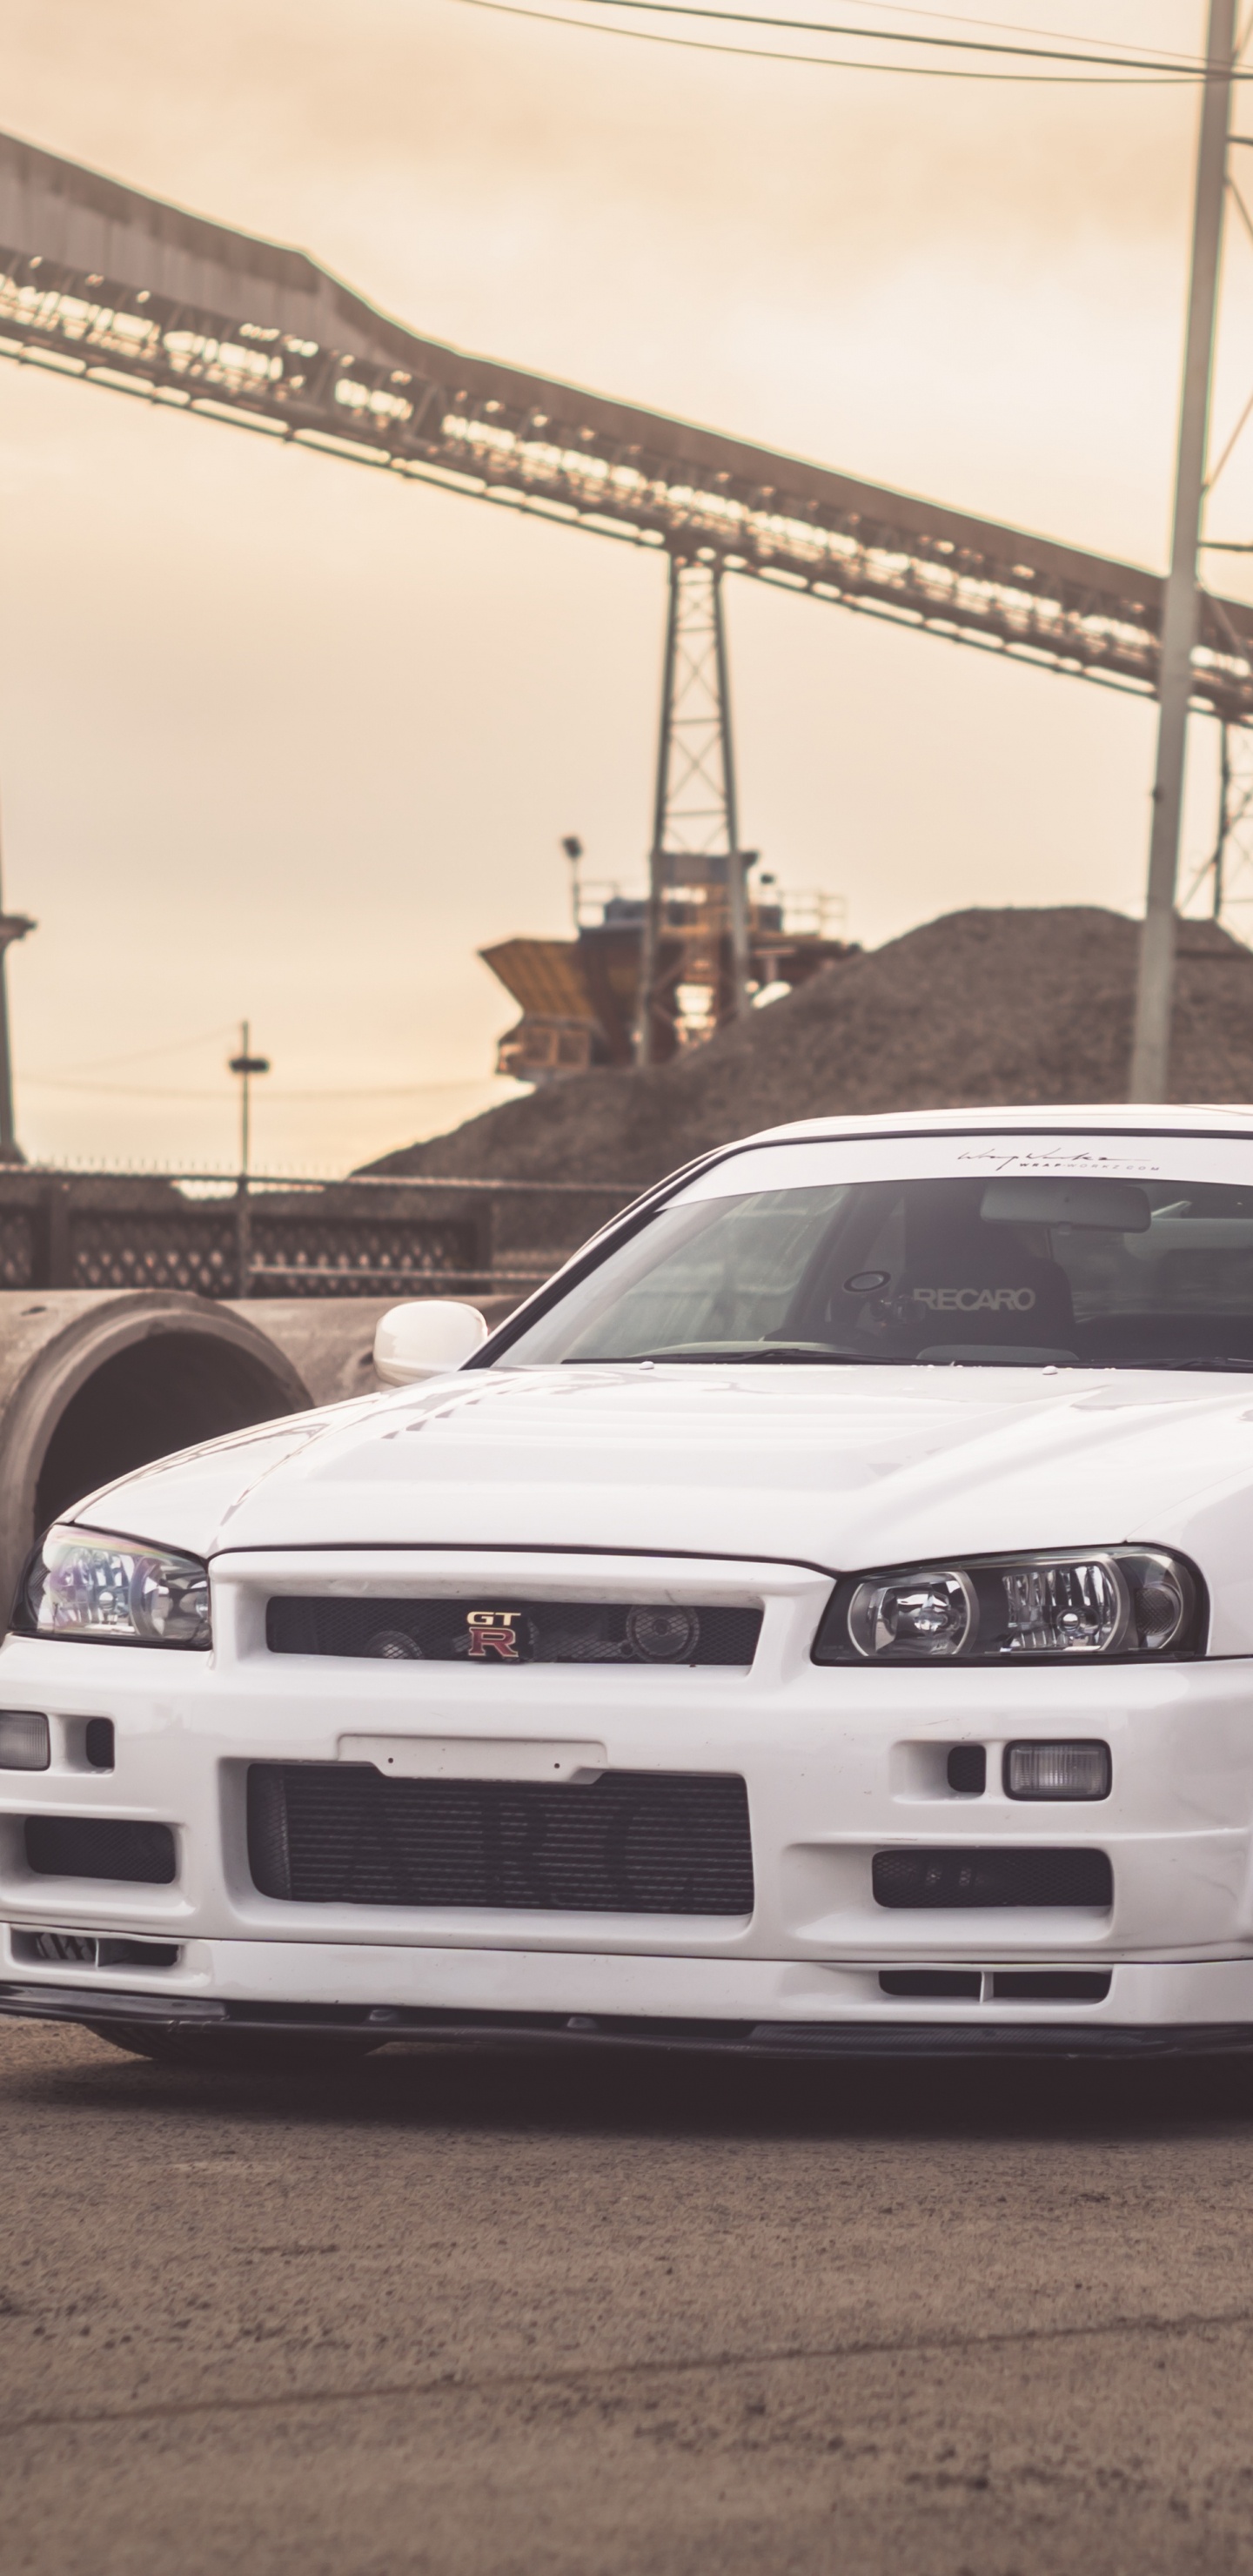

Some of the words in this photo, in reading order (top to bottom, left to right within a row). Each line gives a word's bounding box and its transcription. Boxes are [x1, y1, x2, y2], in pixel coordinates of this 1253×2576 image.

[1019, 1163, 1160, 1171] WRAP-WORKZCOM
[914, 1287, 1036, 1311] RECARO
[467, 1611, 521, 1626] GT
[468, 1627, 519, 1658] R
